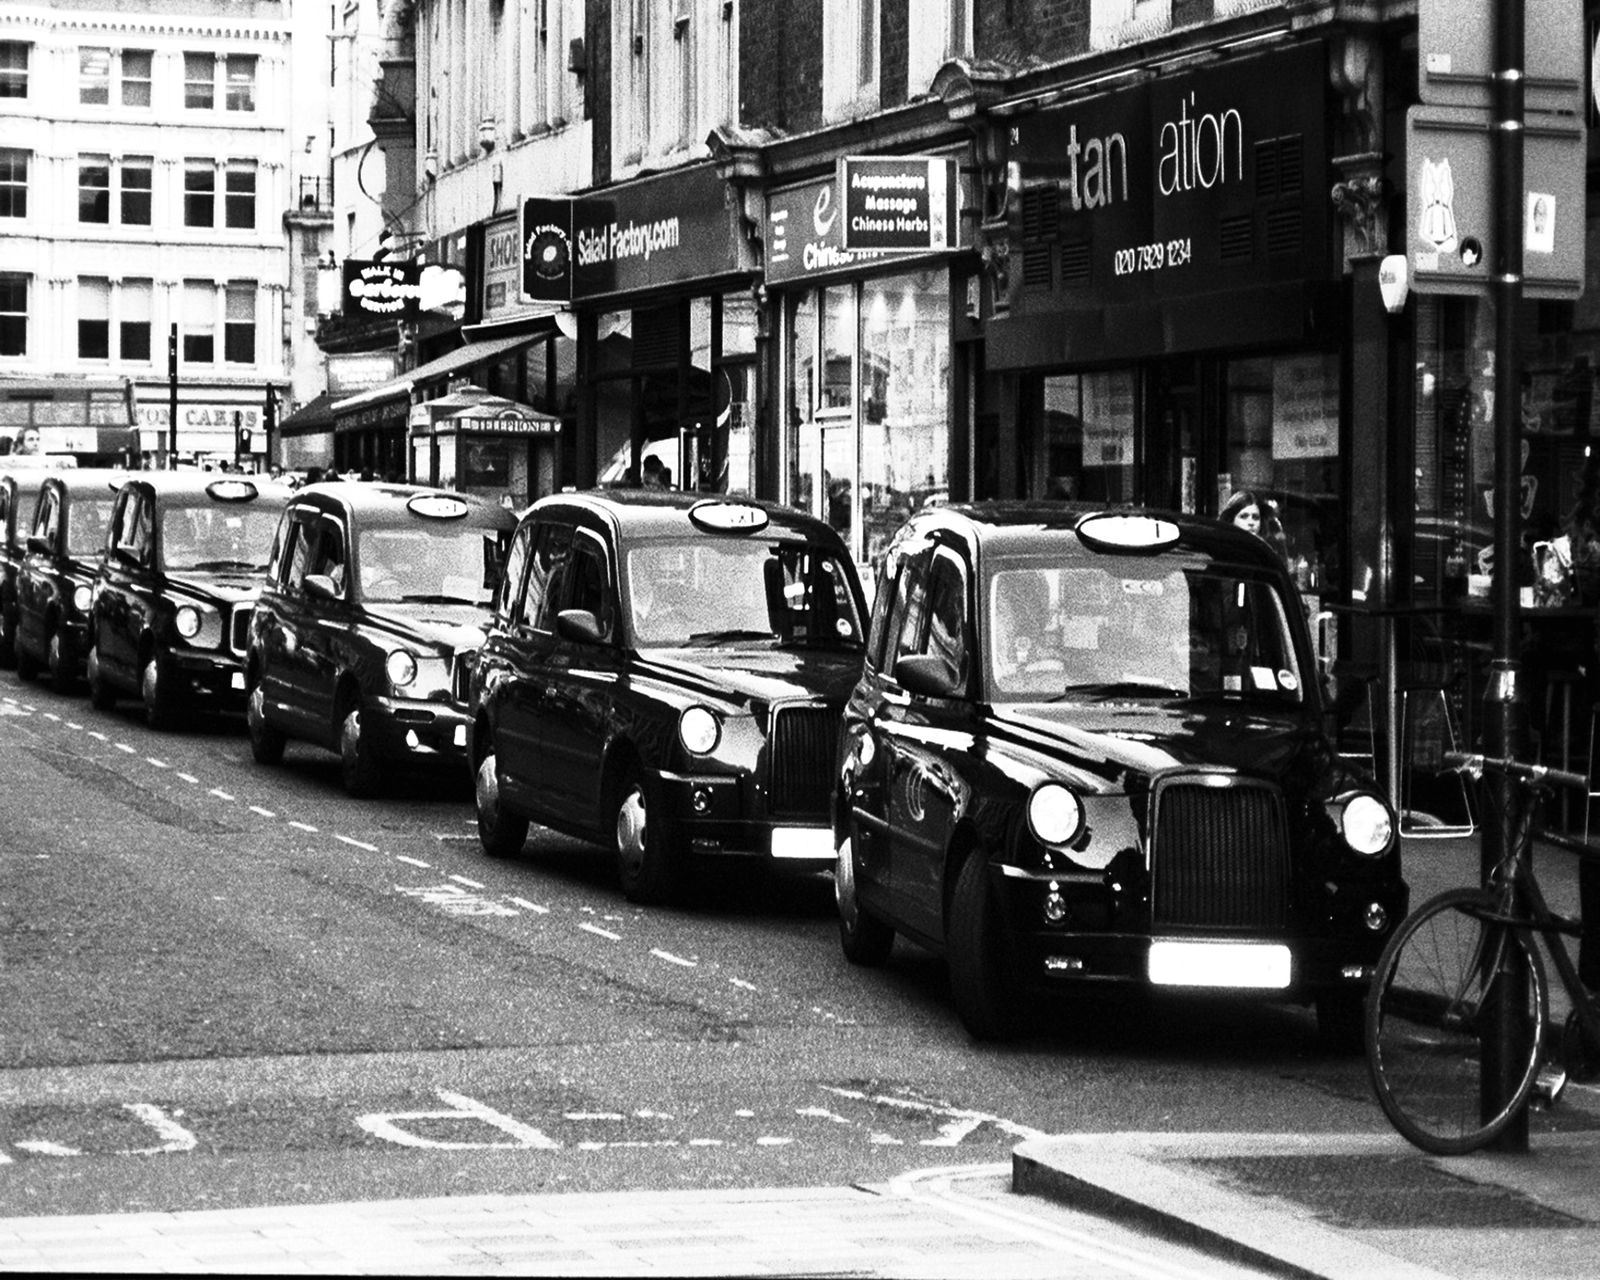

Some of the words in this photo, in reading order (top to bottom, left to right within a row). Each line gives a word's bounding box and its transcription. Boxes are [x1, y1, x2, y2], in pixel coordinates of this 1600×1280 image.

[1067, 124, 1128, 211] tan
[1159, 90, 1242, 195] ation
[851, 172, 925, 191] Acupuncture
[865, 195, 917, 214] Massage
[852, 216, 895, 231] Chinese
[896, 216, 928, 231] Herbs
[578, 226, 607, 266] Salad
[609, 216, 679, 261] Factory.com
[1114, 248, 1135, 276] 020
[1137, 243, 1164, 272] 7929
[1166, 238, 1191, 267] 1234
